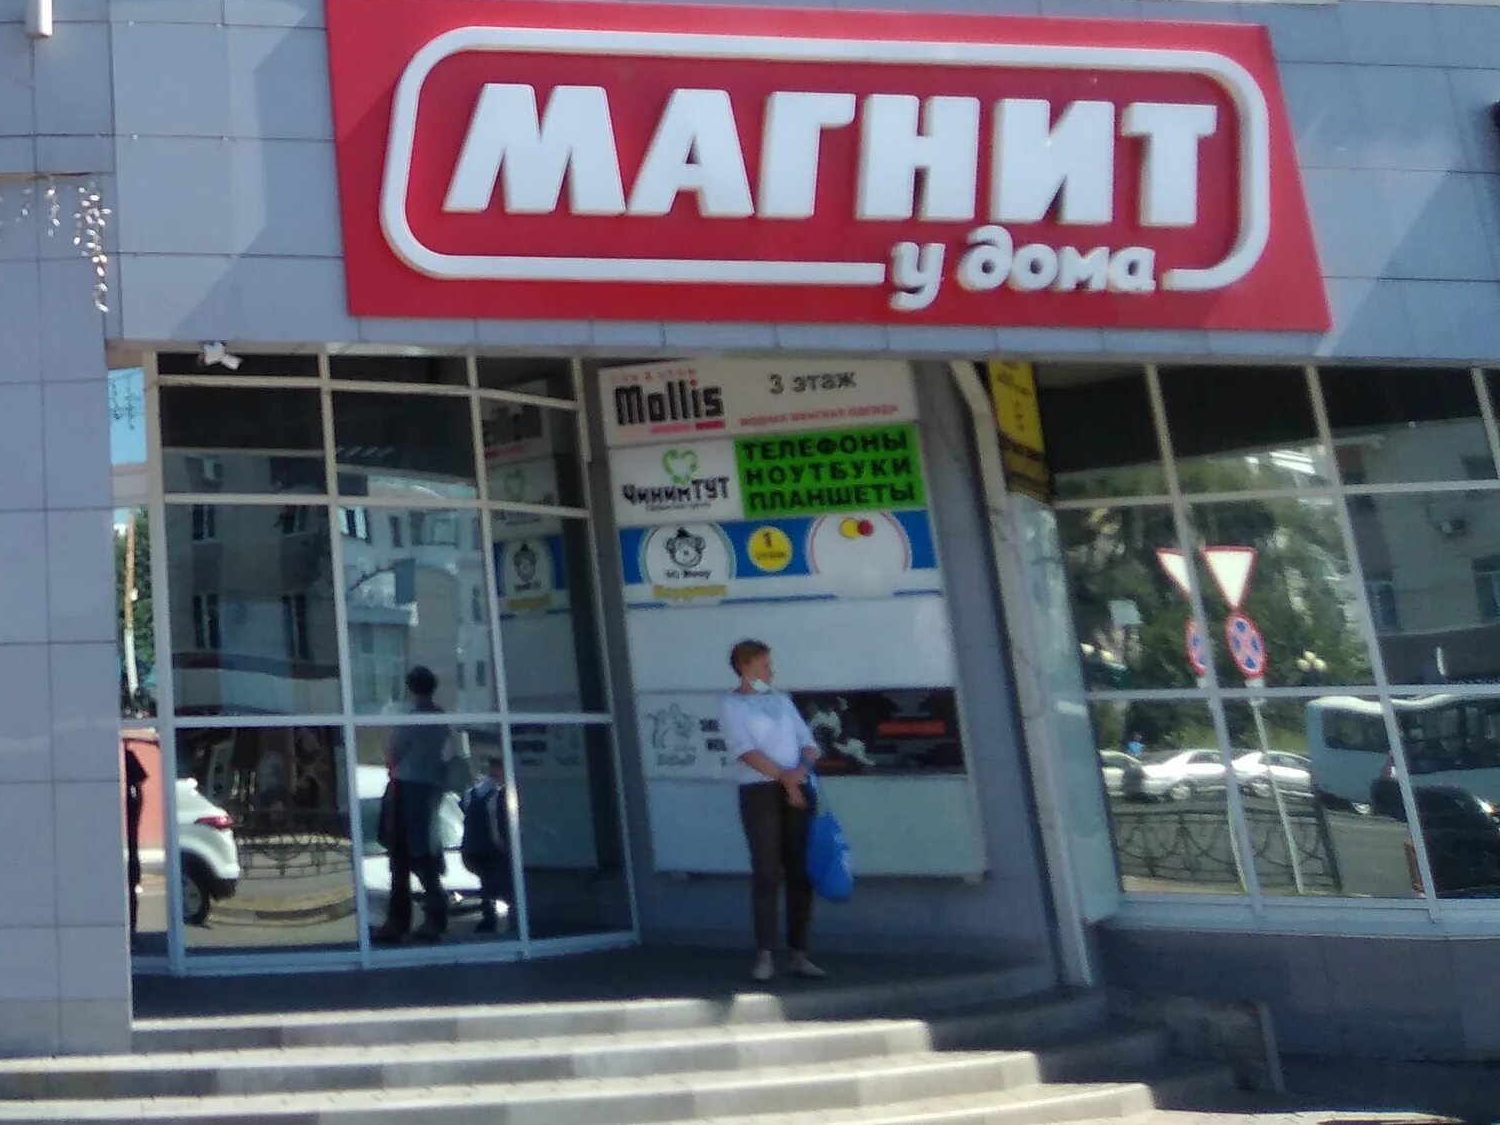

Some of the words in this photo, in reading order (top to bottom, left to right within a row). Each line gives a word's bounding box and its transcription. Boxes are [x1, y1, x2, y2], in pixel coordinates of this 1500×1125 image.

[441, 82, 1218, 229] МАГНИТ
[889, 239, 946, 312] у
[956, 225, 1158, 296] дома
[769, 373, 785, 395] 3
[792, 371, 858, 393] этаж
[614, 377, 725, 426] Mollis
[742, 430, 908, 462] ТЕЛЕФОНЫ
[745, 456, 912, 486] НОУТБУКИ
[749, 482, 915, 511] ПЛАНШЕТЫ
